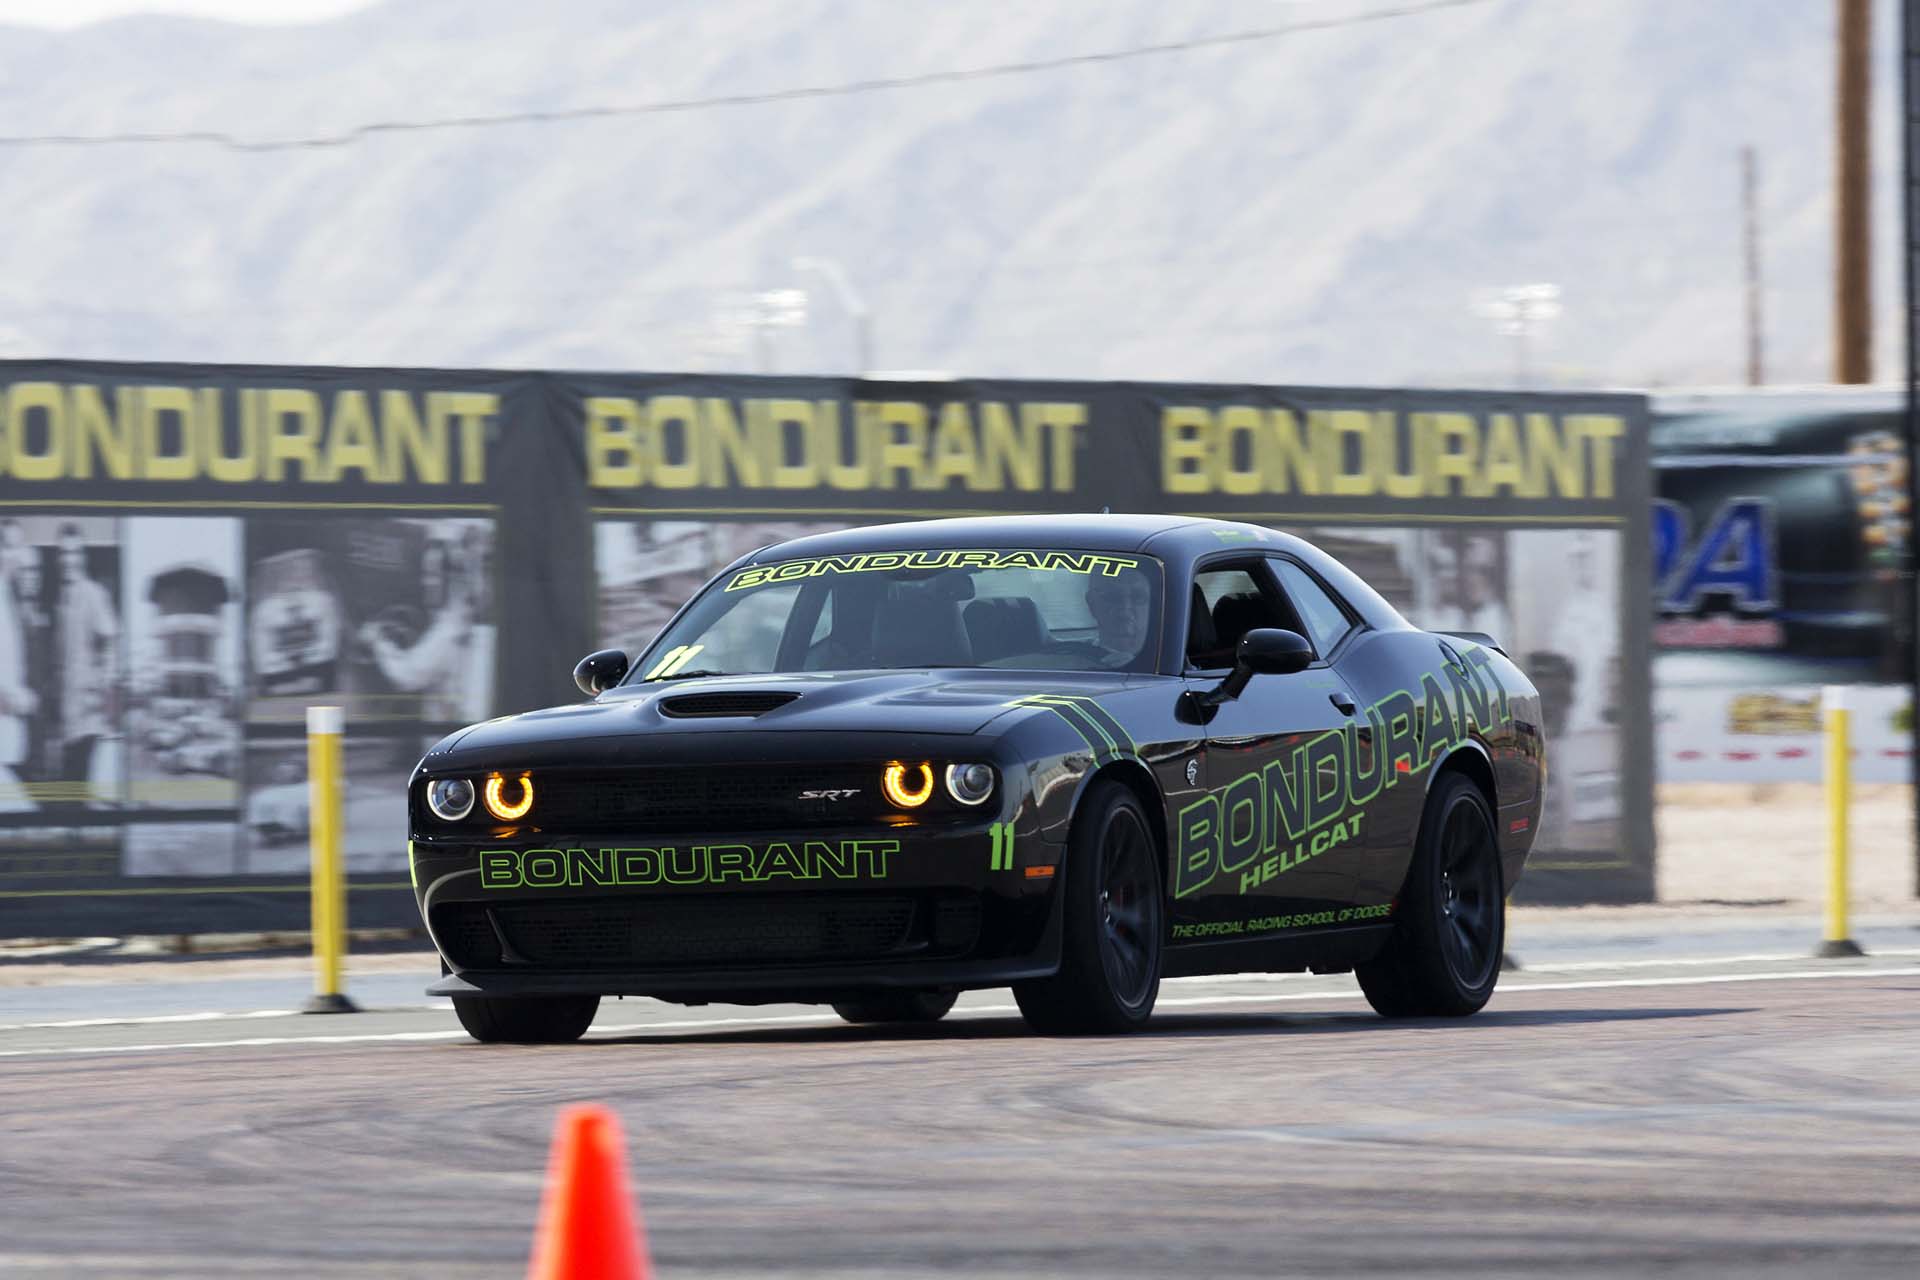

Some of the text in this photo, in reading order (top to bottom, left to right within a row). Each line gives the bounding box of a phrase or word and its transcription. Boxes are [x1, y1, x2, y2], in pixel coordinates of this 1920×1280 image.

[0, 381, 499, 485] ONDURANT
[585, 396, 1088, 491] BONDURANT
[1161, 405, 1625, 499] BONDURANT
[724, 550, 1138, 592] BONDURANT
[798, 788, 861, 801] SRT
[1175, 645, 1512, 899] BONDURANT
[480, 840, 900, 888] BONDURANT
[989, 821, 1016, 871] 11
[1239, 813, 1365, 895] HELLCAT
[1172, 904, 1393, 939] THE OFFICIAL RACING SCHOOL OF DODGE
